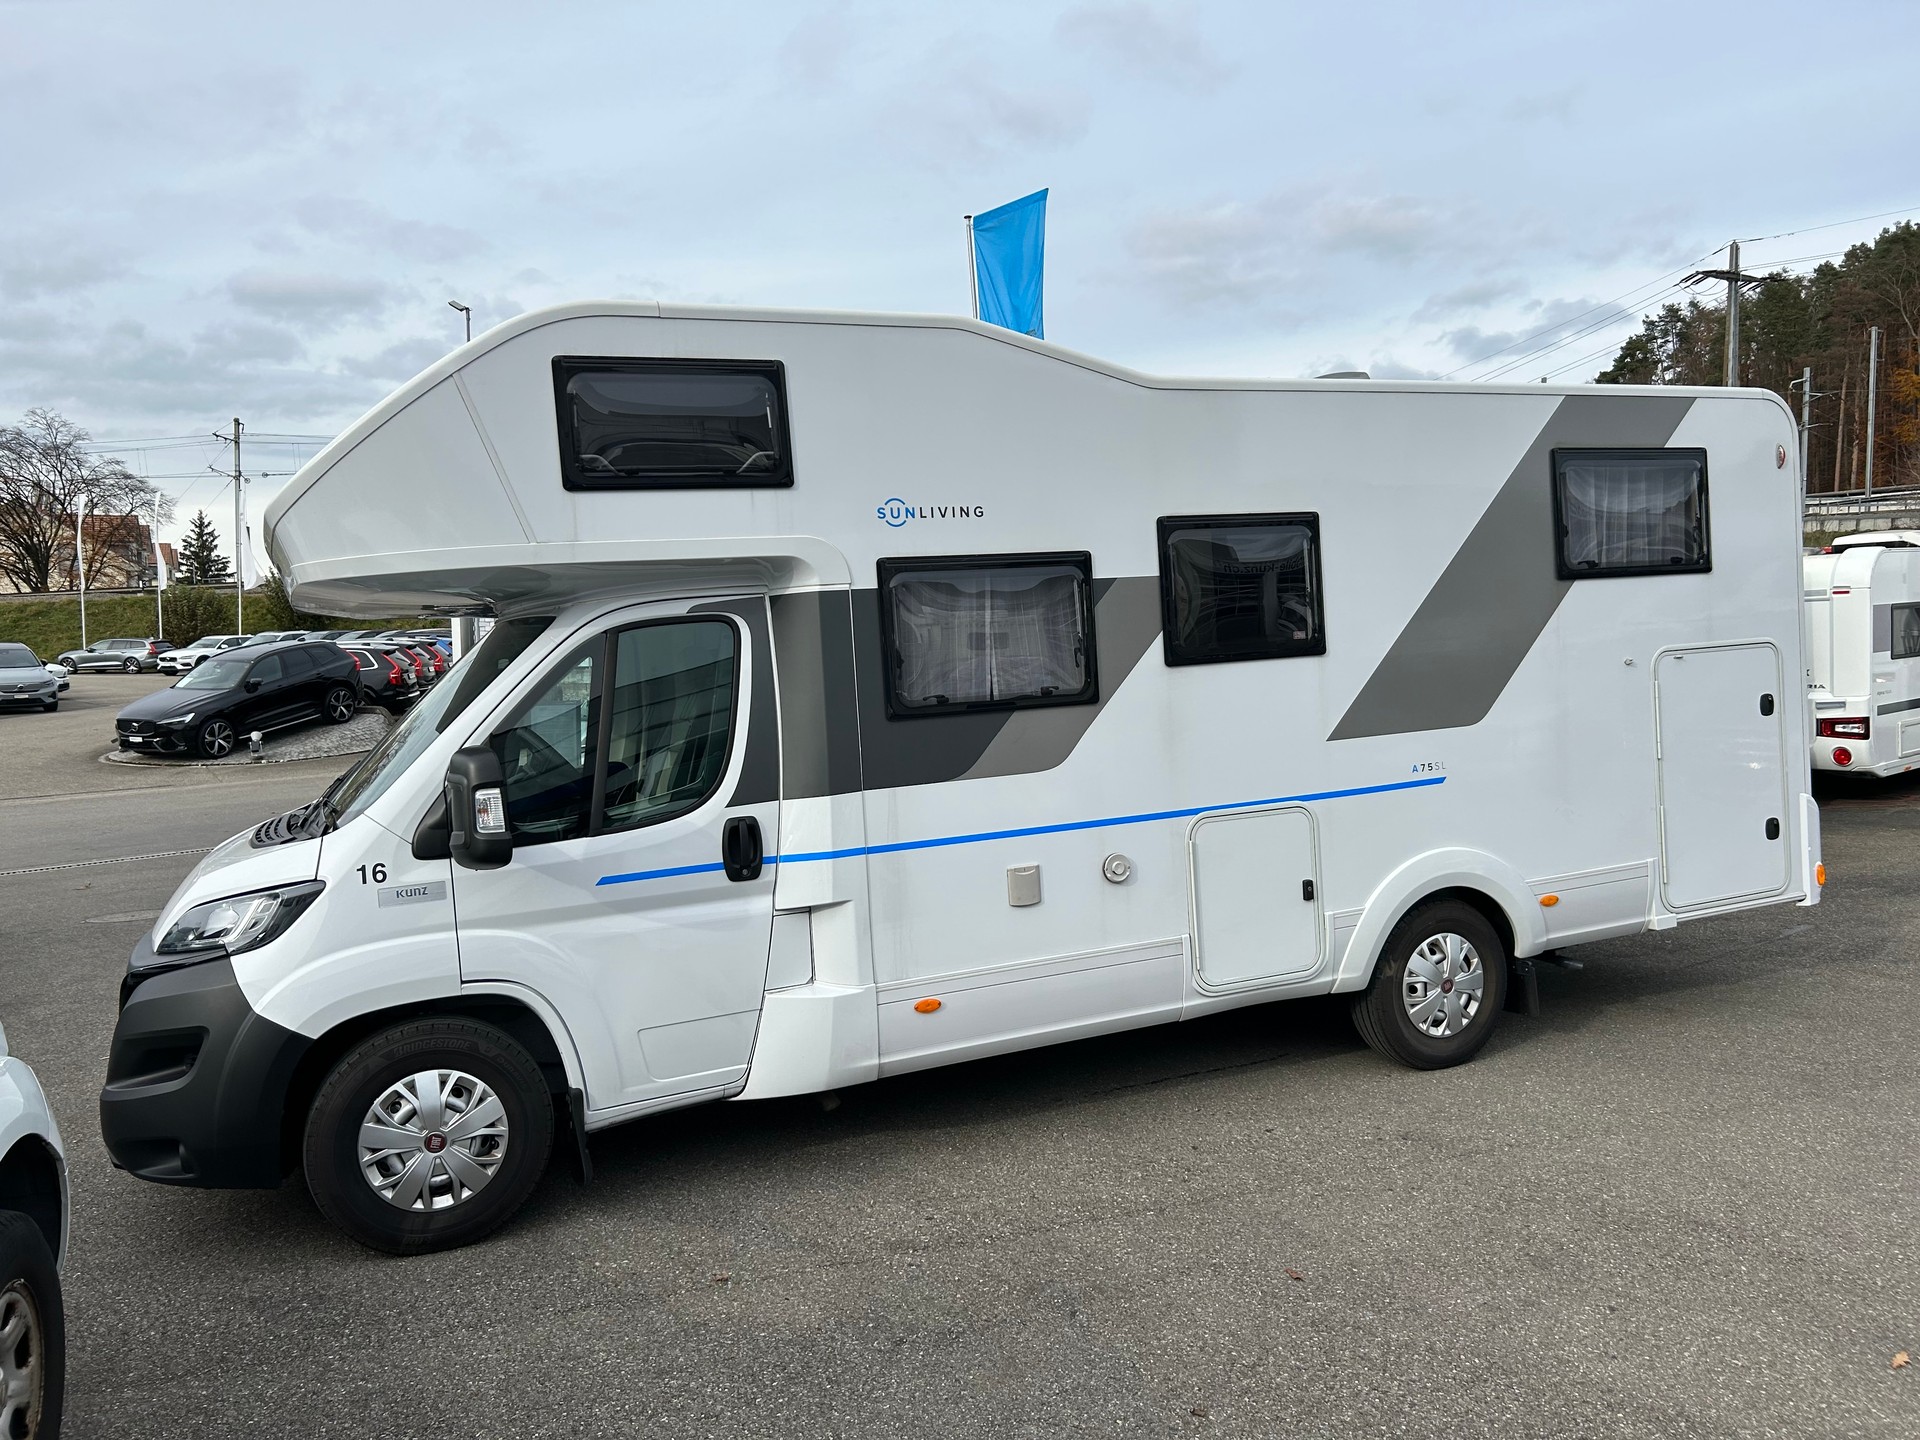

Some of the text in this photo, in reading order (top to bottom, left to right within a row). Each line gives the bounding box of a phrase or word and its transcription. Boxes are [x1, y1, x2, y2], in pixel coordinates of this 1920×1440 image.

[876, 504, 985, 521] SUNLIVING
[1411, 761, 1447, 773] A75SL
[356, 862, 387, 885] 16
[393, 1038, 472, 1056] BRIDGESTONE
